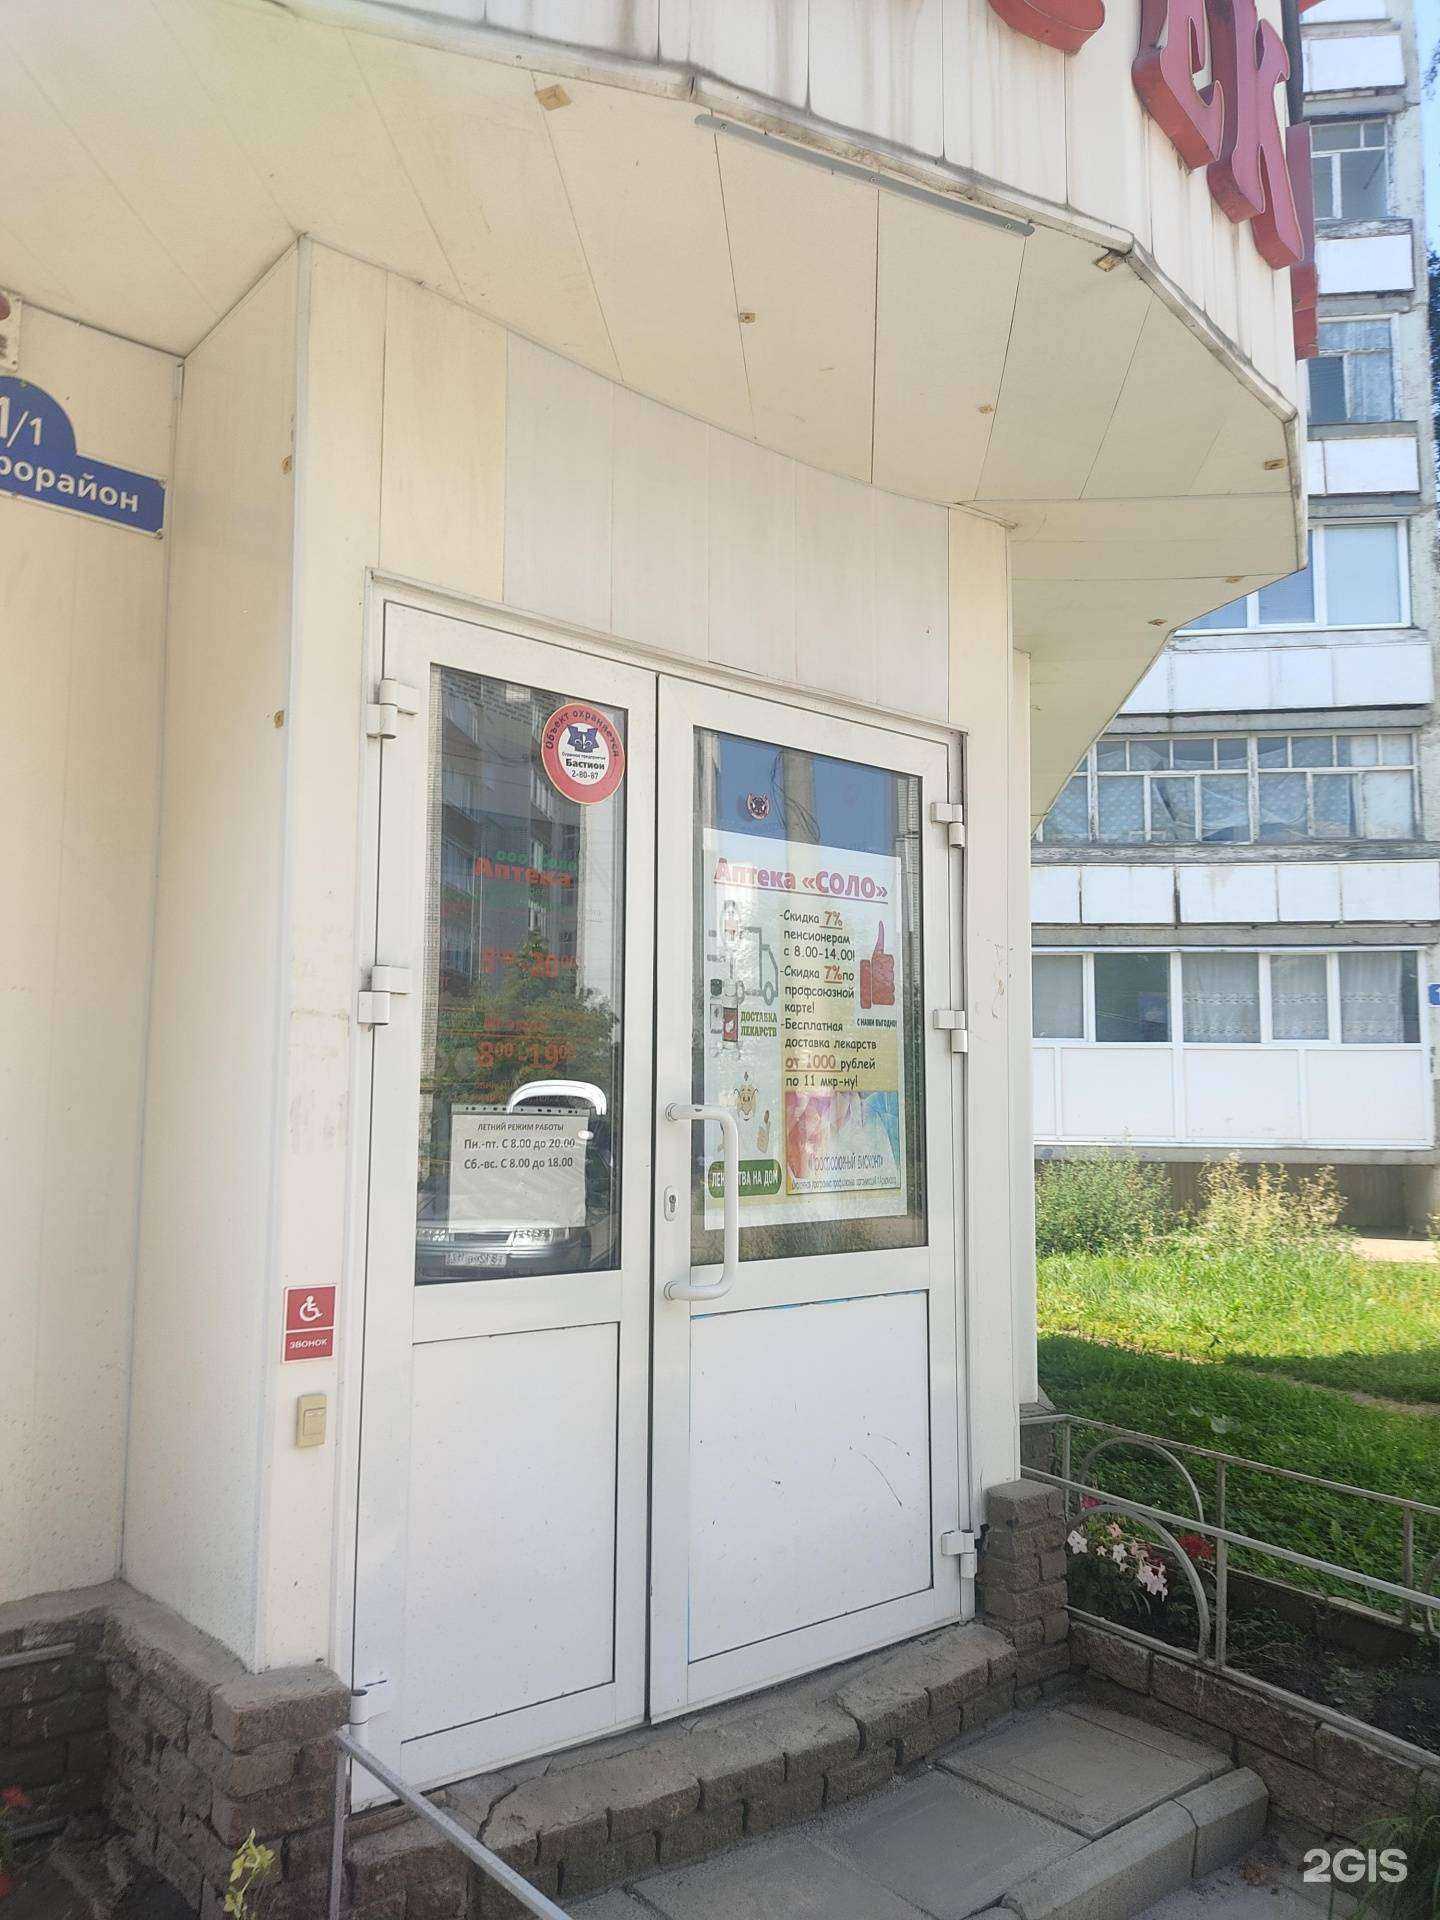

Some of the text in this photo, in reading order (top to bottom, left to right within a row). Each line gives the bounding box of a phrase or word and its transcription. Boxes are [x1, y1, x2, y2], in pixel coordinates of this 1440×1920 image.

[566, 758, 605, 770] Бастион
[473, 856, 575, 890] Аптека
[714, 857, 888, 899] Аптека «СОЛО»
[823, 910, 843, 927] 7%
[783, 930, 851, 945] пенсионерам
[784, 985, 855, 999] профсоюзной
[784, 1001, 815, 1015] карте!
[741, 1011, 777, 1023] ДОСТАВКА
[740, 1026, 777, 1037] ЛЕКАРСТВ
[784, 1038, 877, 1053] доставка лекарств
[785, 1054, 876, 1071] от 1000 рублей
[786, 1077, 799, 1087] по
[804, 1075, 815, 1087] 11
[478, 1123, 564, 1131] ЛЕТНИЙ РЕЖИМ РАБОТЫ
[464, 1139, 576, 1150] Пн.-пт. С 8.00 до 20.00
[464, 1157, 573, 1170] Сб.-вс. С 8.00 до 18.00
[711, 1170, 751, 1187] ЛЕКТВА
[753, 1170, 763, 1185] НА
[764, 1169, 779, 1186] ДОМ
